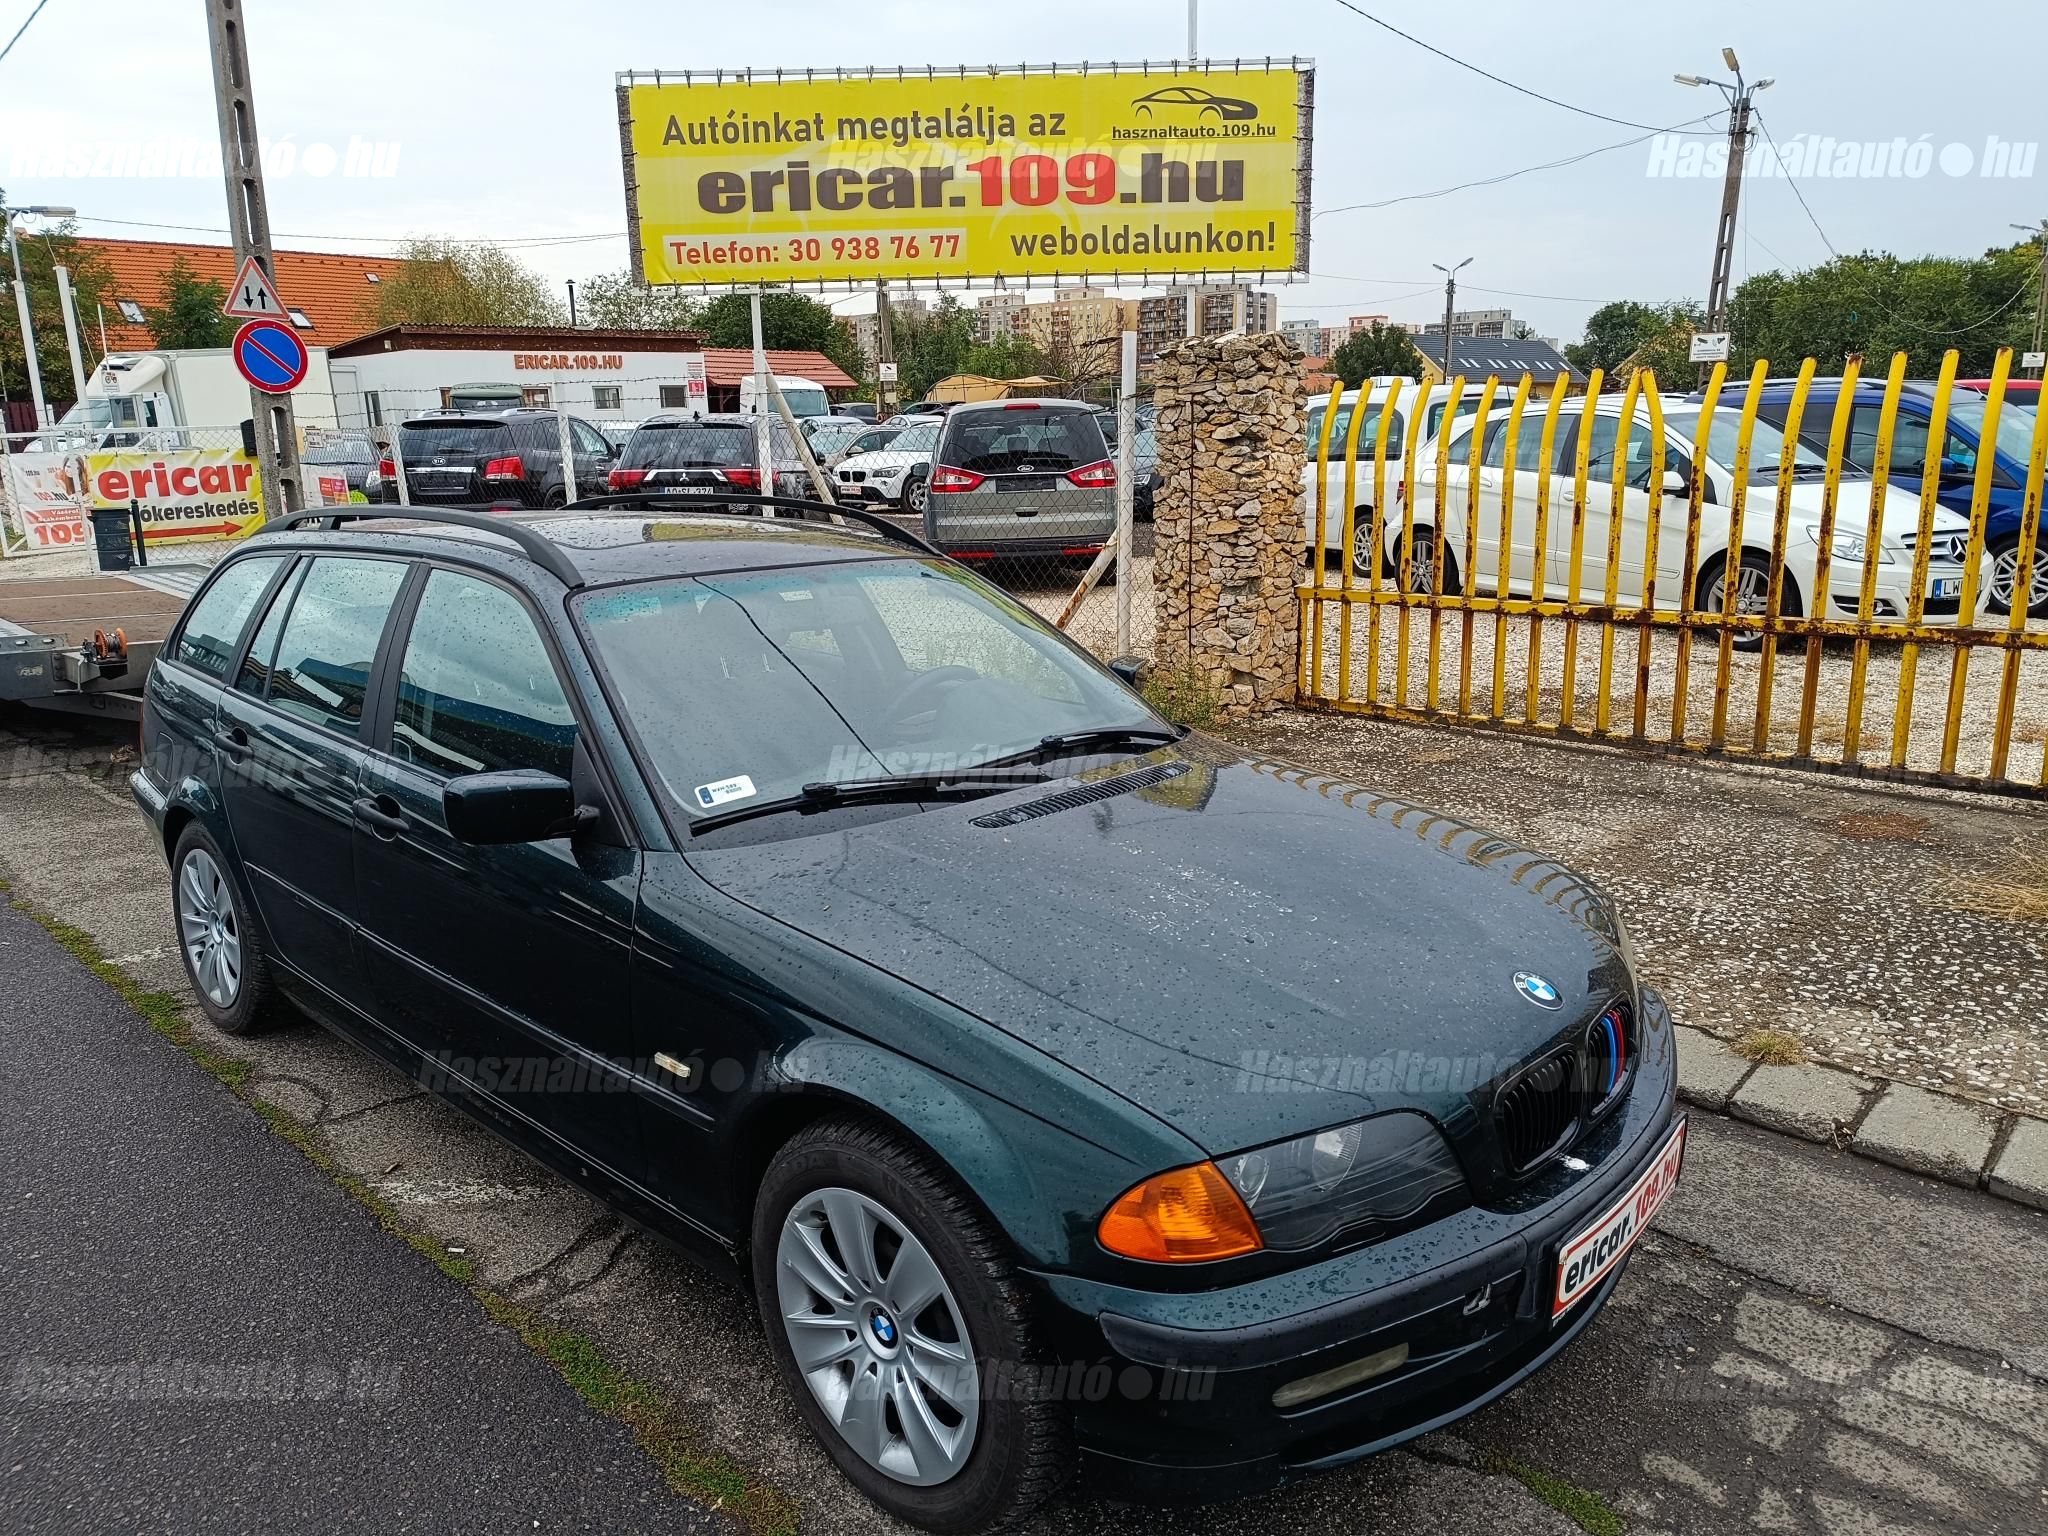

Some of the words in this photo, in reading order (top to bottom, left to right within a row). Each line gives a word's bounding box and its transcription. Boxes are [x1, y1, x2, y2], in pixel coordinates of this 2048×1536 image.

[662, 109, 824, 145] Autóinkat
[837, 103, 1015, 147] megtalálja
[1028, 113, 1066, 136] az
[1112, 123, 1276, 139] hasznaltauto.109.hu
[697, 152, 1244, 214] ericar.109.hu
[670, 241, 779, 265] Telefon:
[788, 238, 821, 262] 30
[831, 237, 880, 260] 938
[890, 235, 920, 259] 76
[929, 234, 961, 258] 77
[1011, 221, 1276, 257] weboldalunkon!
[514, 354, 623, 370] ERICAR.109.HU
[97, 461, 254, 500] ericar
[139, 498, 260, 525] ókereskedés
